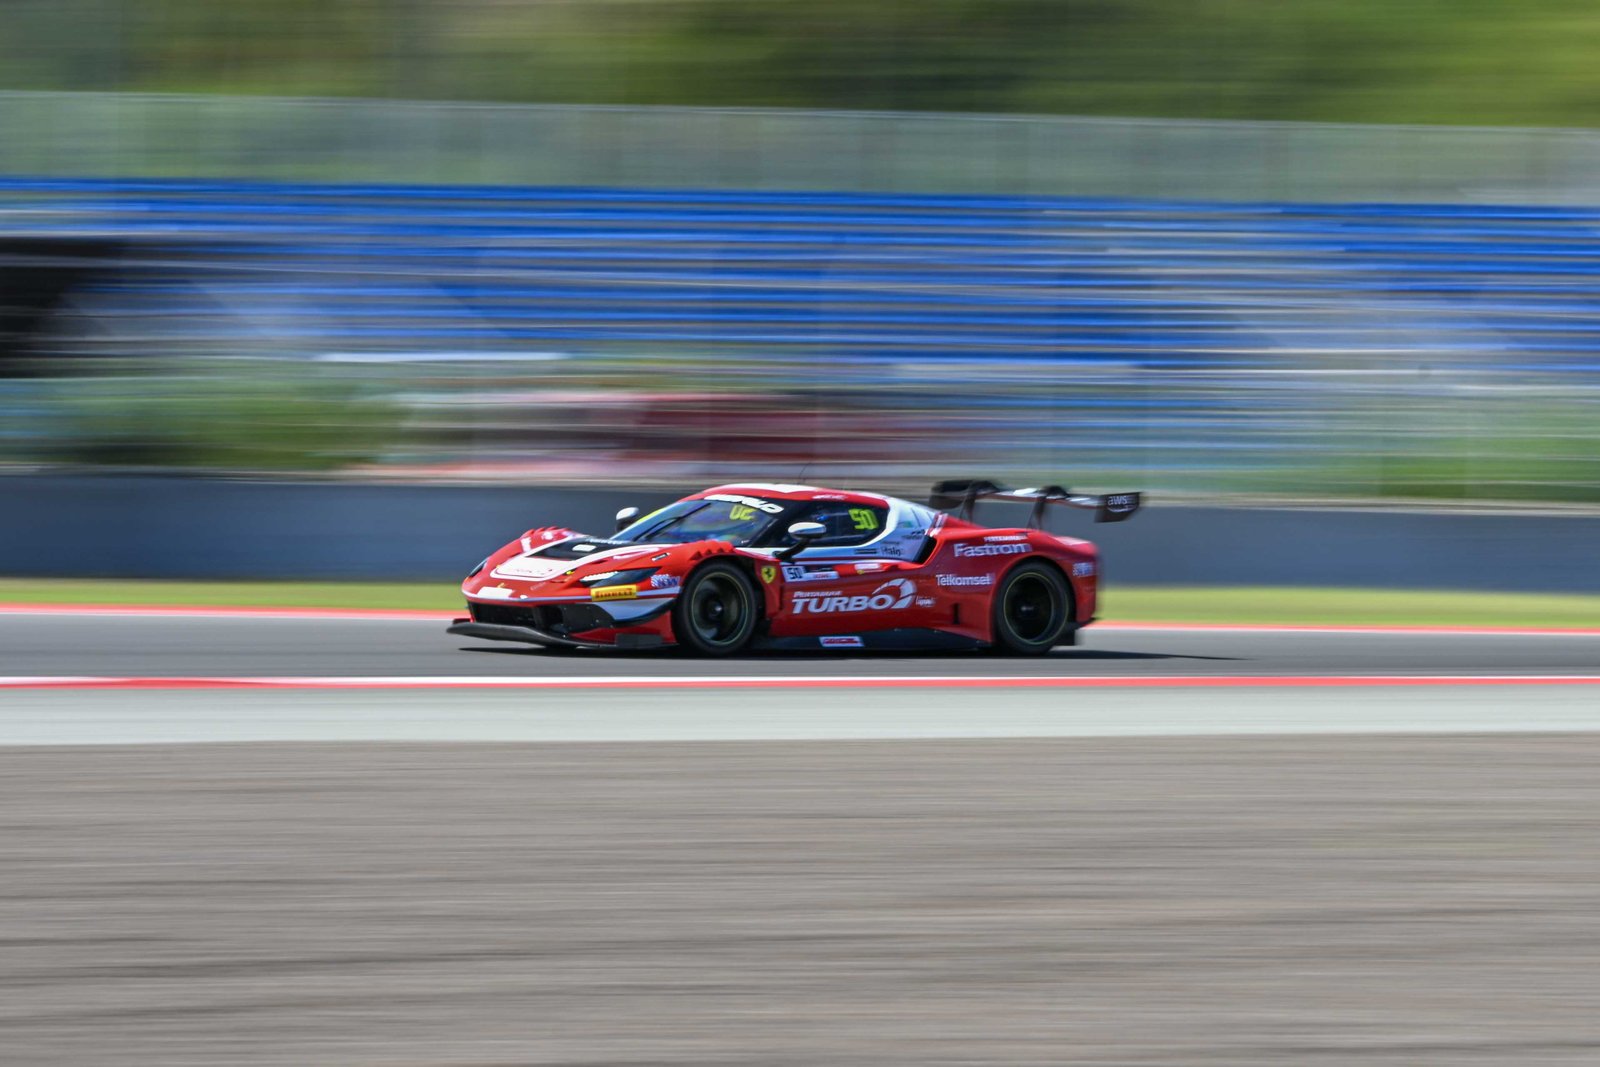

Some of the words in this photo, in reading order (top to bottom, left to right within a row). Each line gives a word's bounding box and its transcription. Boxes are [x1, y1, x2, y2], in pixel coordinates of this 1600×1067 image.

[848, 508, 879, 530] 50
[953, 542, 1031, 558] Fastron
[936, 572, 995, 586] Telkomsel
[791, 594, 896, 614] TURBO
